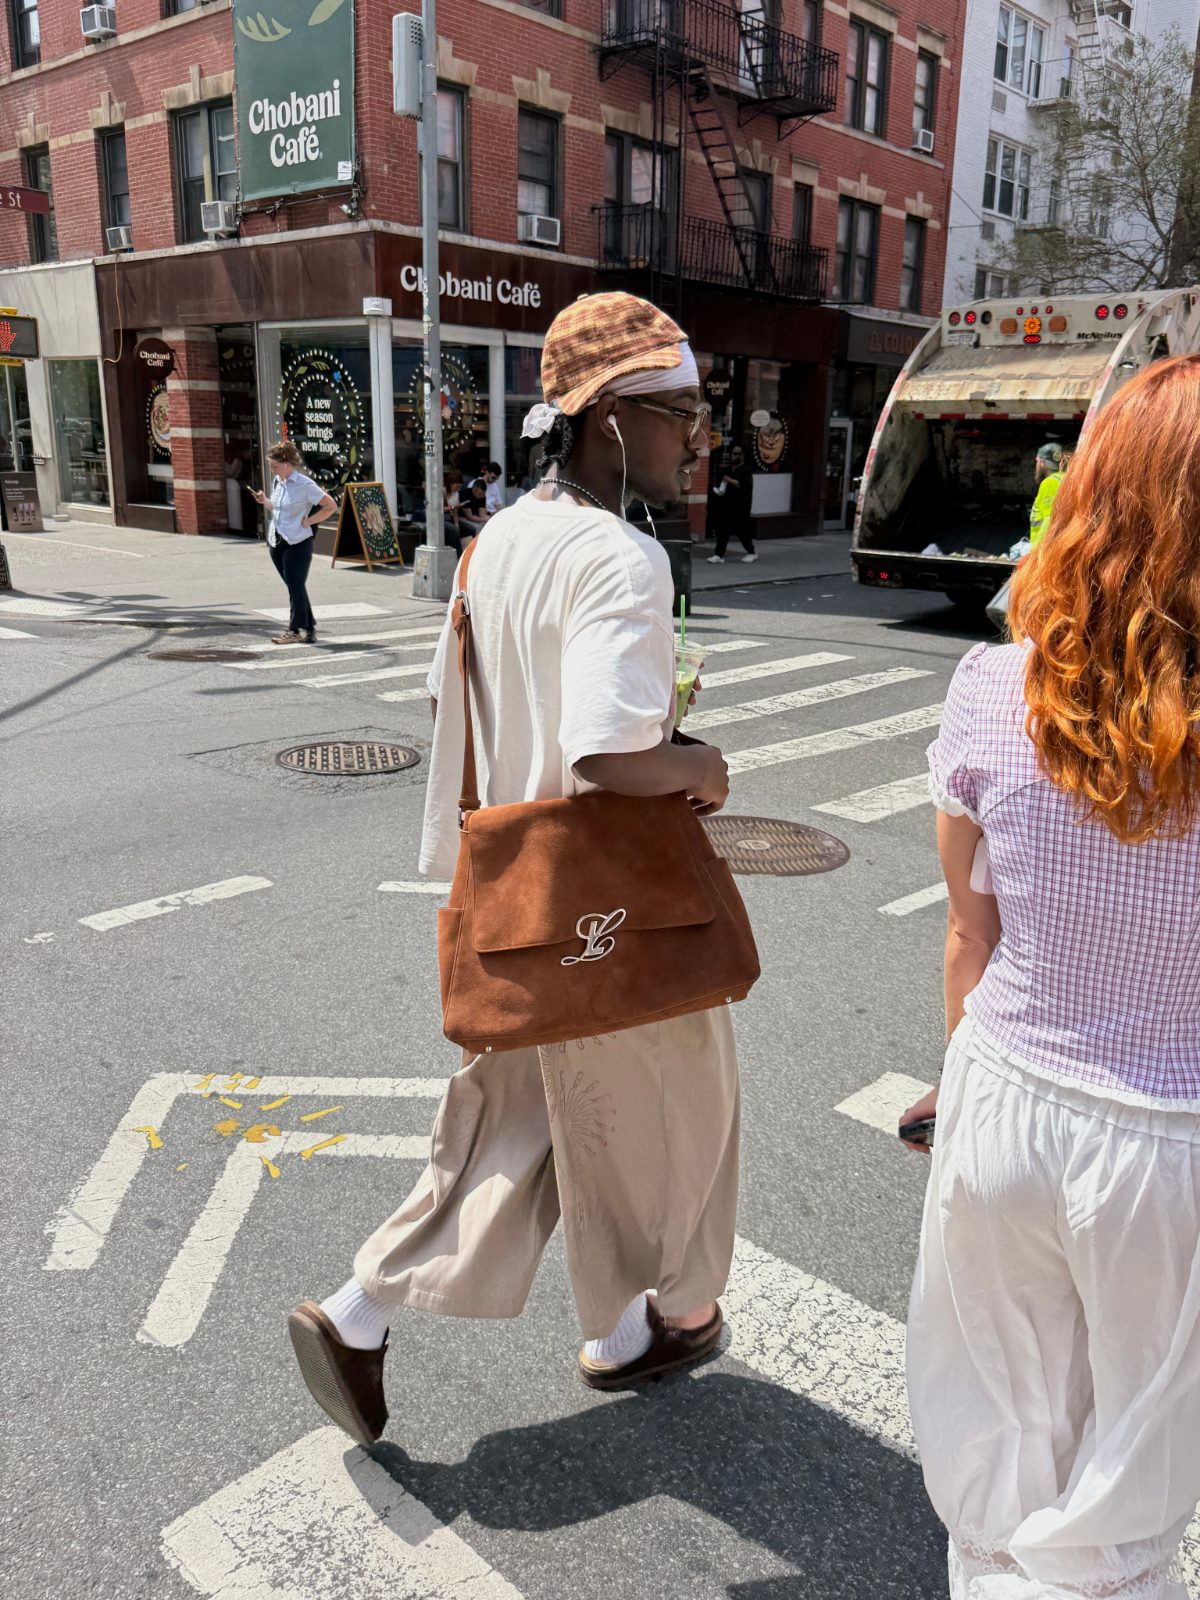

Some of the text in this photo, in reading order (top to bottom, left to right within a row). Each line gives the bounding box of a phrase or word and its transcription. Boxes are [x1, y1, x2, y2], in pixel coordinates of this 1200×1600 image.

[249, 79, 341, 135] Chobani
[270, 125, 319, 168] Café
[8, 191, 22, 208] St
[496, 279, 541, 309] Café
[1076, 331, 1123, 340] McNeilus
[139, 350, 171, 361] Chobani
[146, 358, 164, 367] Café
[306, 396, 331, 409] A new
[304, 412, 334, 423] season
[307, 425, 334, 441] brings
[302, 440, 341, 456] new hope
